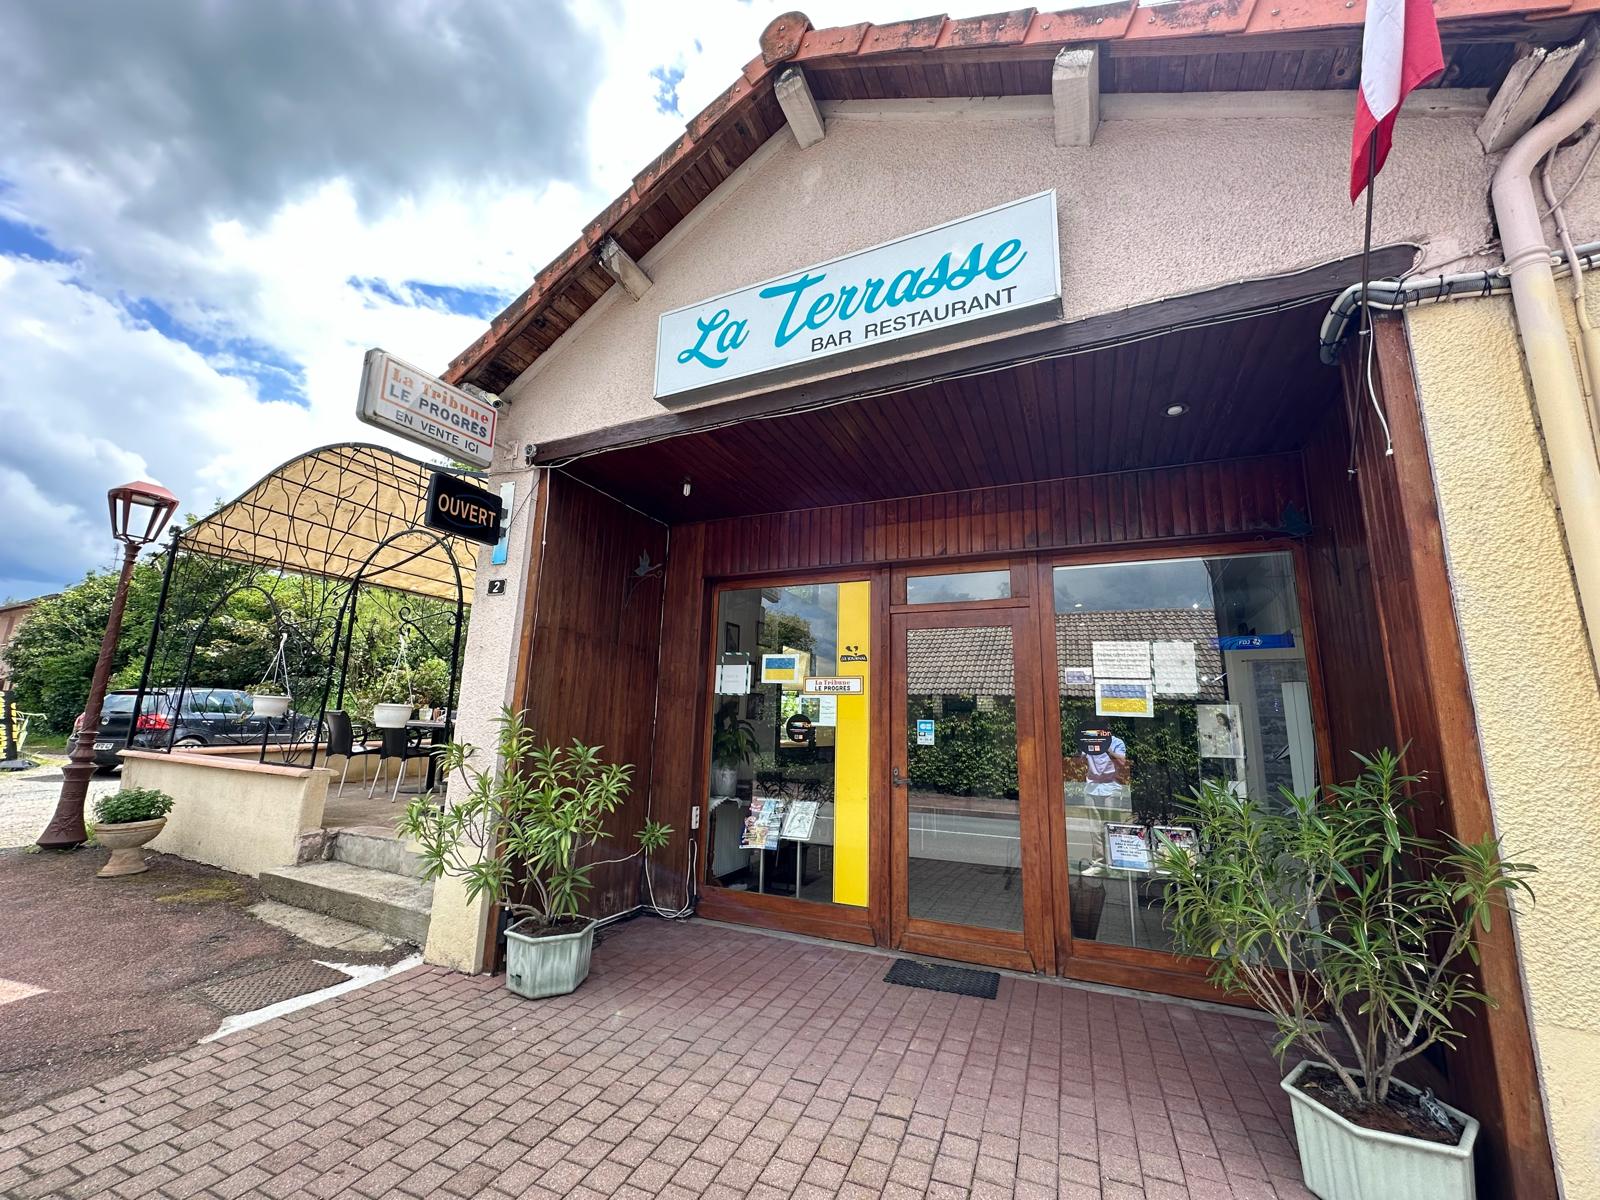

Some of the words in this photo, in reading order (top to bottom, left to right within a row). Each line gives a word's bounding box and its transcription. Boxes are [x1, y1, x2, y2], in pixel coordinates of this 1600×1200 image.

[677, 308, 751, 369] La
[759, 238, 1028, 349] Terrasse
[810, 329, 852, 353] BAR
[864, 285, 1018, 340] RESTAURANT
[389, 384, 411, 403] LE
[392, 367, 414, 388] La
[422, 382, 489, 424] Tribune
[395, 409, 414, 426] EN
[420, 420, 460, 445] VENTE
[464, 439, 480, 454] ICI
[437, 493, 497, 529] OUVERT
[492, 581, 501, 593] 2
